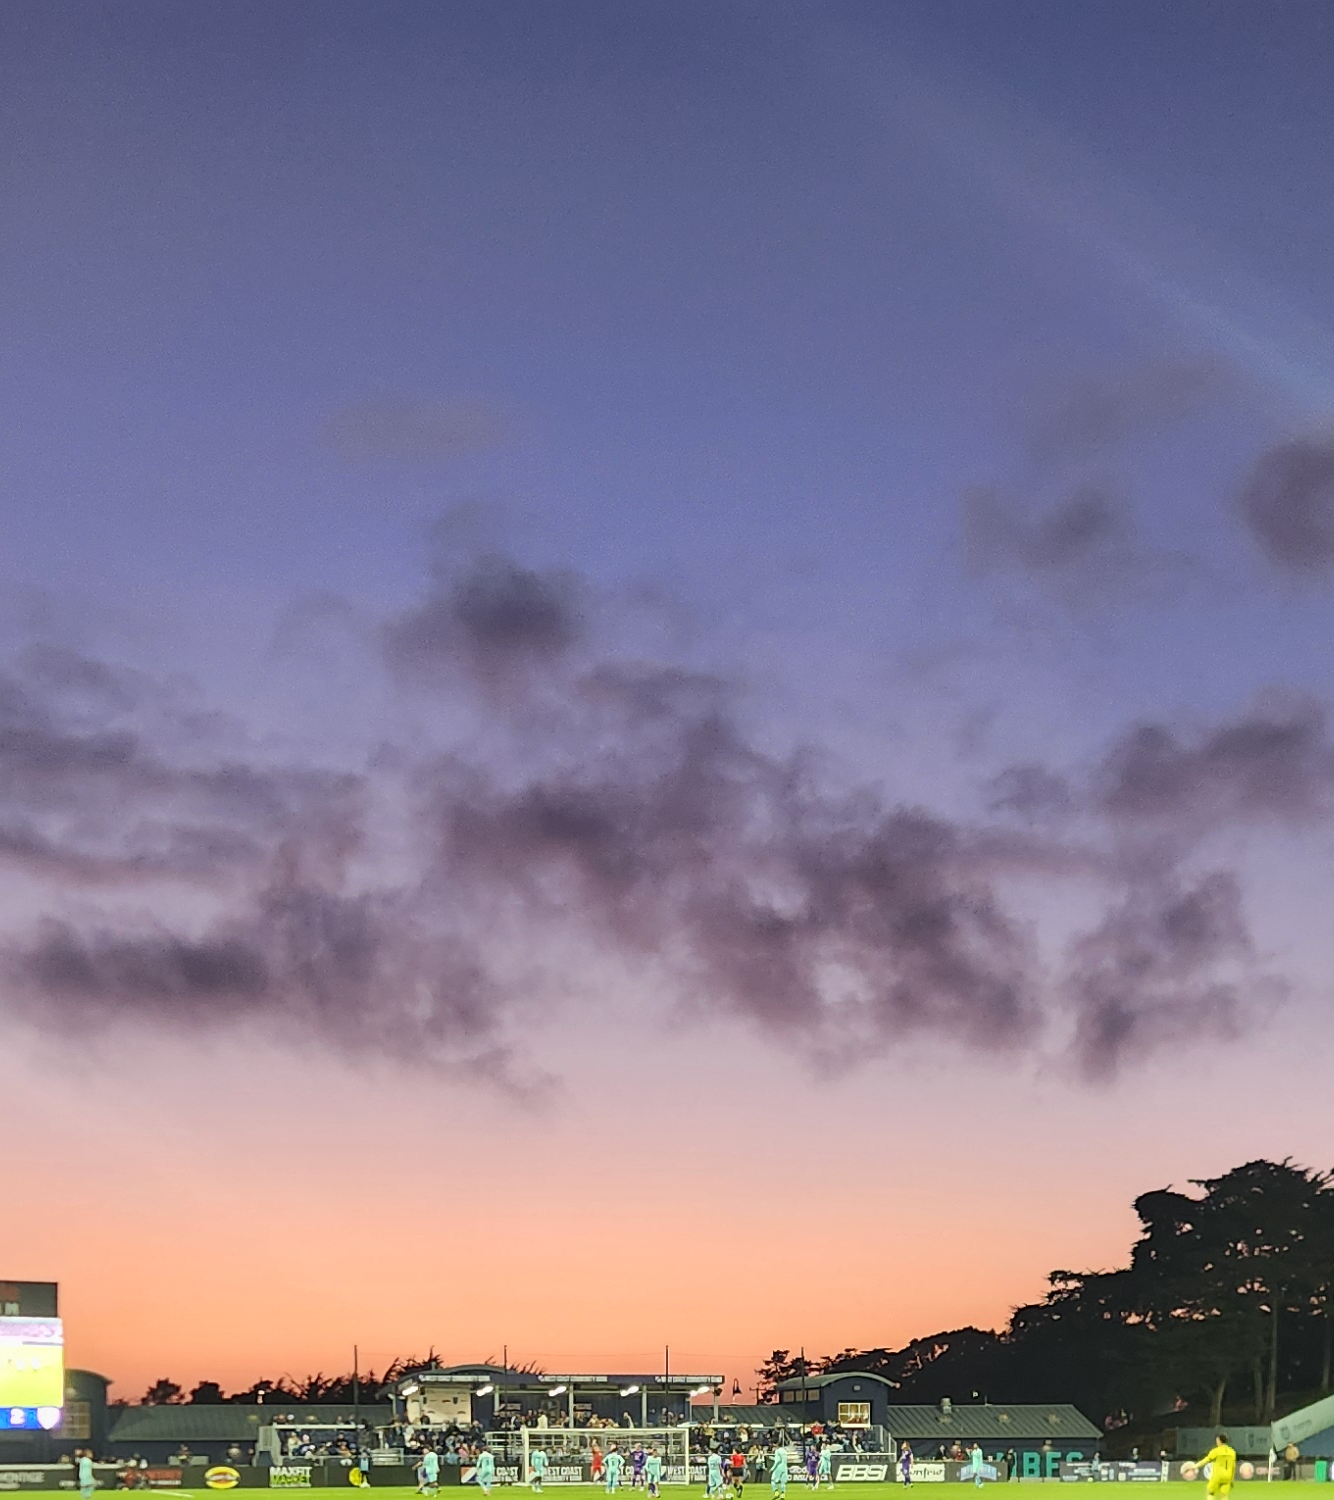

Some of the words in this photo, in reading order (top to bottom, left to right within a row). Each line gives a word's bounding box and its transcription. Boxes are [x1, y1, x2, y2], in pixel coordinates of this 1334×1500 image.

[269, 1466, 312, 1476] MAXFIT
[561, 1466, 584, 1477] COAST
[836, 1464, 888, 1481] BBSI
